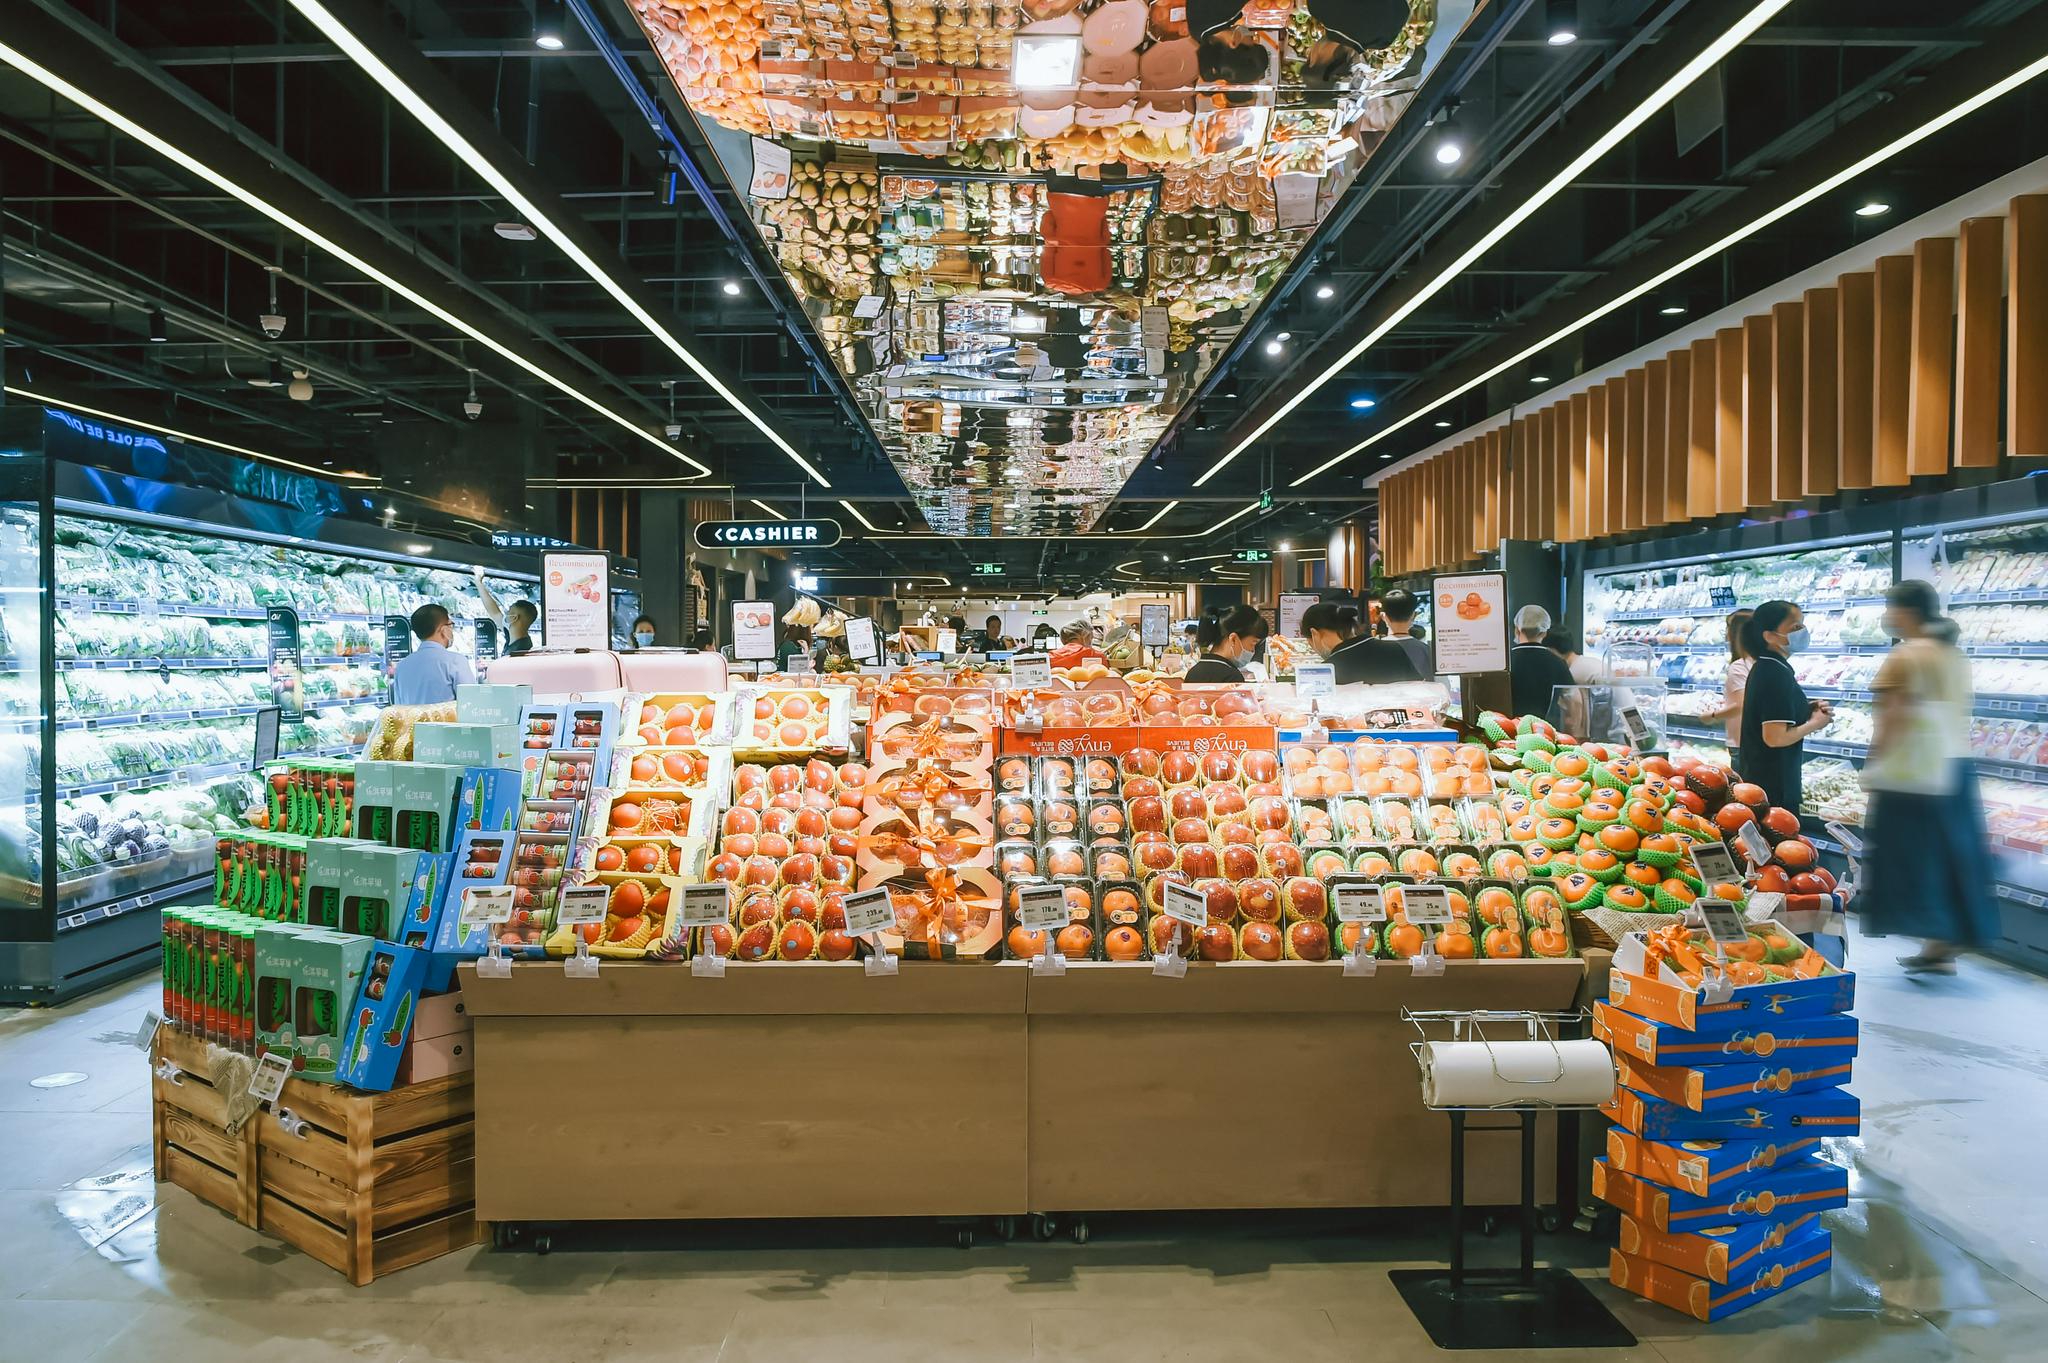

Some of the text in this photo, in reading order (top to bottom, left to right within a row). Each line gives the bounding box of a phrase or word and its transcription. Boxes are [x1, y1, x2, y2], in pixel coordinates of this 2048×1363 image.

[726, 526, 818, 542] CASHIER
[549, 559, 604, 568] Recommended
[1438, 579, 1499, 590] Recommended
[1074, 733, 1112, 753] envy
[1209, 732, 1247, 751] envy
